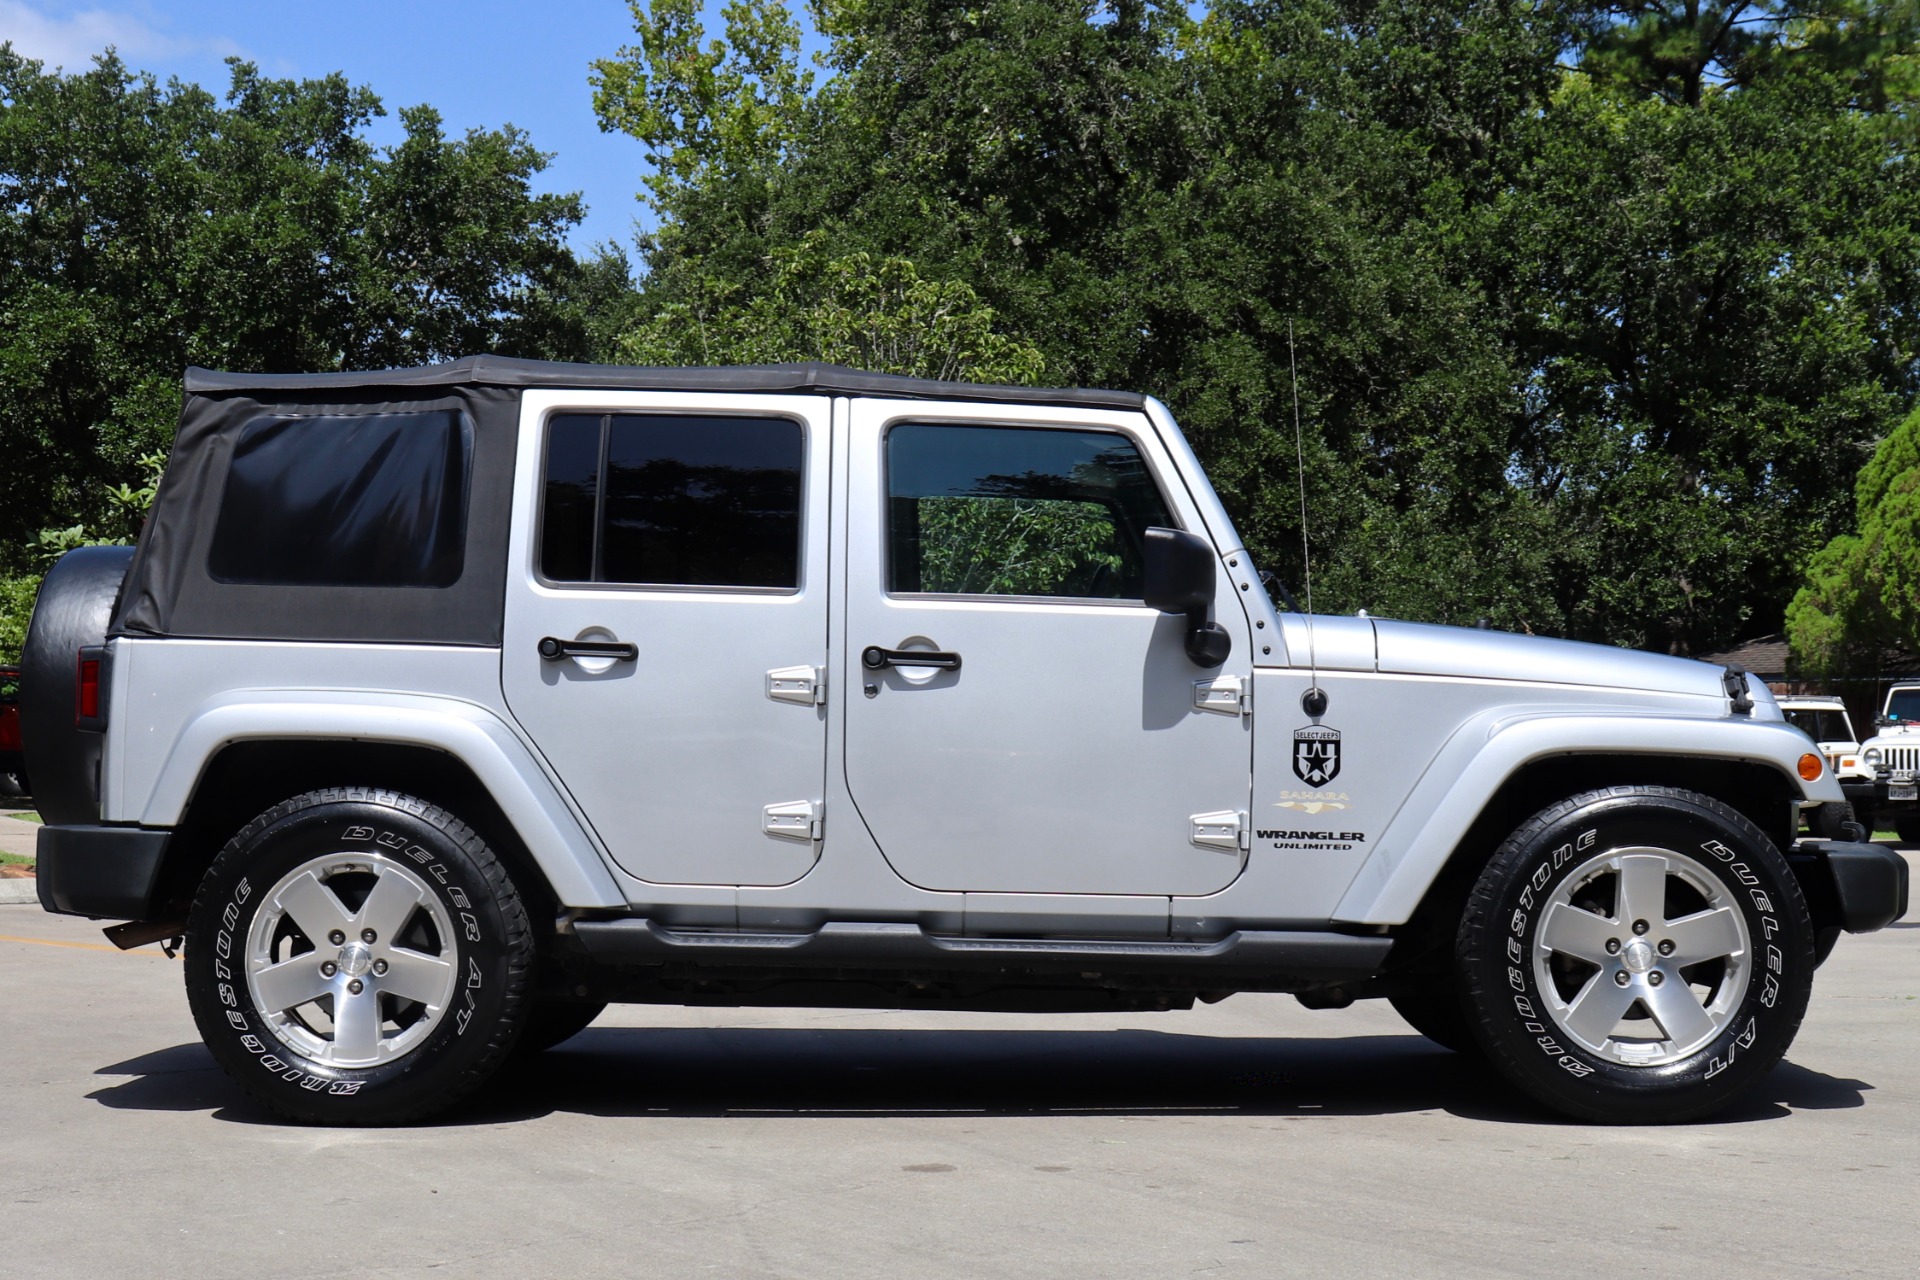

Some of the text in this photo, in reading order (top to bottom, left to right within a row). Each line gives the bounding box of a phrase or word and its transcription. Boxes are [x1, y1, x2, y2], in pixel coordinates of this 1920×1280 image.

[1296, 731, 1339, 740] SELECT JEEPS
[1256, 829, 1366, 842] WRANGLER
[1273, 842, 1352, 851] UNLIMITED
[1279, 790, 1349, 801] SAHARA
[341, 825, 482, 1035] DUELER A/T
[1507, 828, 1598, 1078] BRIDGESTONE
[1700, 839, 1783, 1080] DUELER A/T
[216, 877, 367, 1095] BRIDGESTONE
